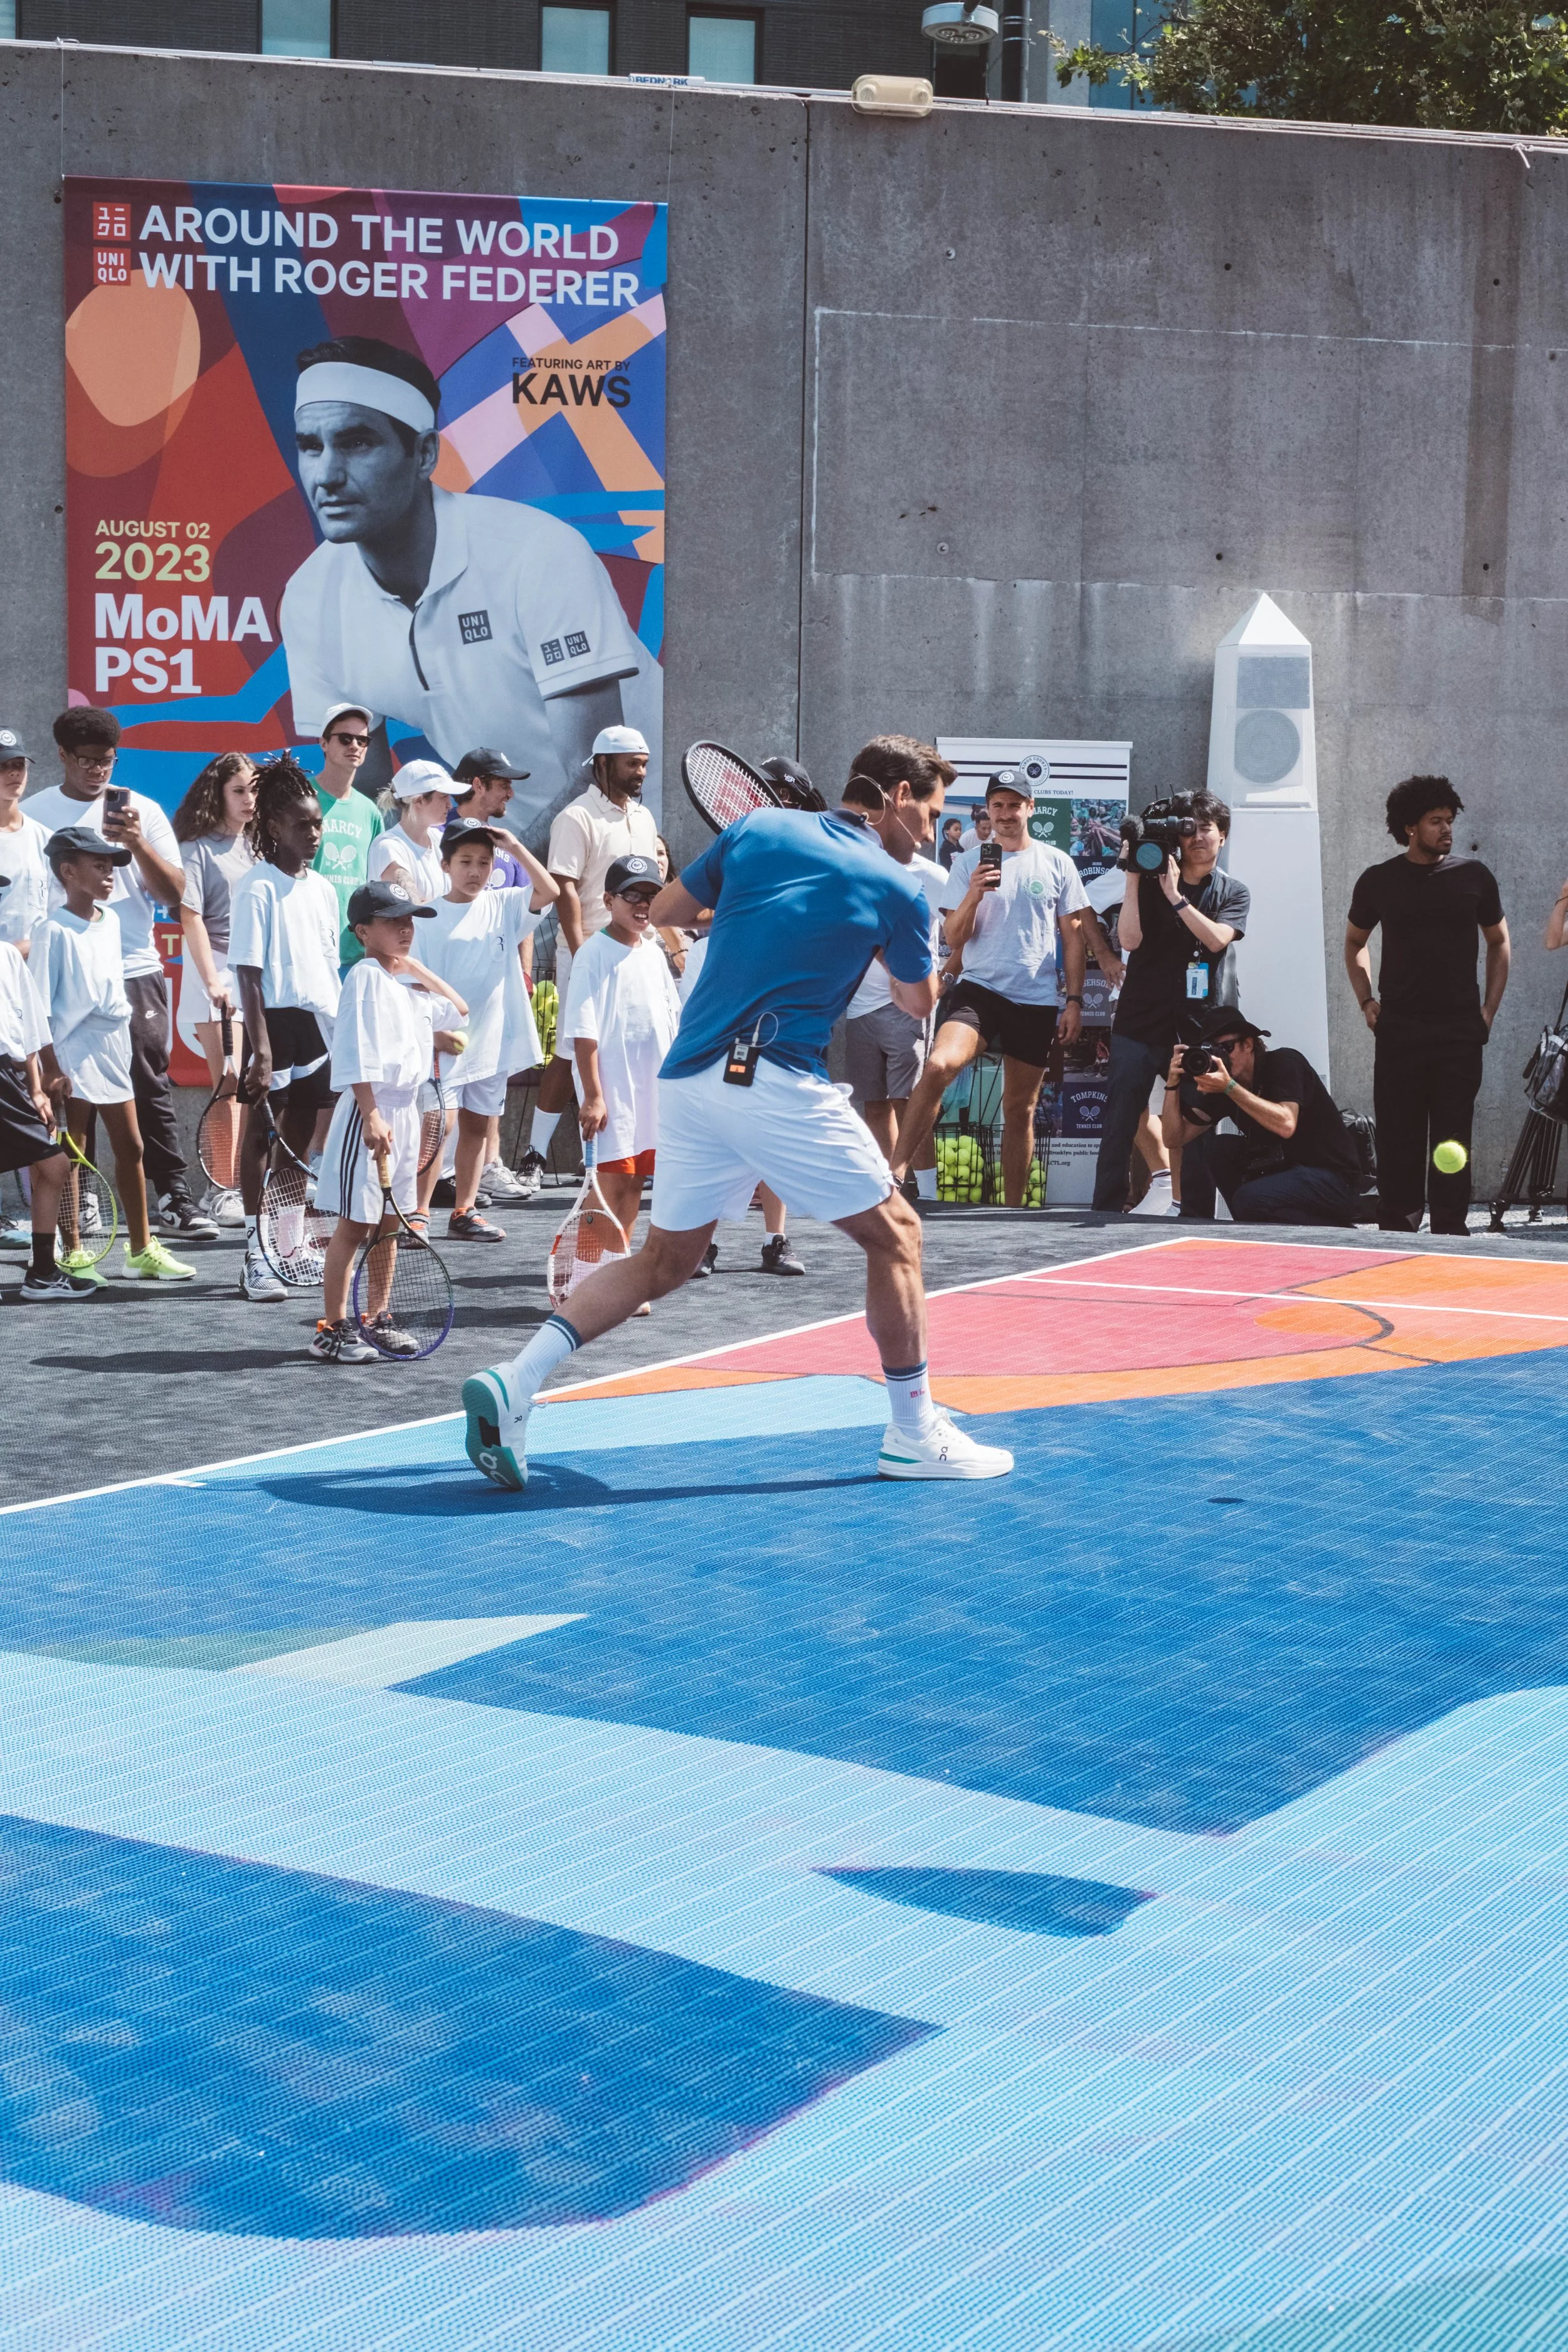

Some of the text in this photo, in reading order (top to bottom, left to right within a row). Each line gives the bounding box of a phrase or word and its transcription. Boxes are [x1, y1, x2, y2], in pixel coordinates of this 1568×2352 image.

[635, 76, 688, 85] BEDNRK
[139, 205, 619, 260] AROUND THE WORLD
[98, 252, 124, 266] UNI
[98, 267, 127, 283] QLO
[139, 252, 639, 307] WITH ROGER FEDERER
[512, 357, 630, 371] FEATURING ART BY
[512, 372, 631, 408] KAWS
[95, 520, 210, 539] AUGUST 02
[95, 541, 210, 582] 2023
[95, 593, 273, 642] MoMA
[462, 614, 484, 627] UNI
[464, 627, 488, 642] QLO
[567, 634, 583, 645] UNI
[570, 643, 587, 655] QLO
[95, 647, 202, 694] PS1
[1078, 867, 1110, 878] ROBINSO
